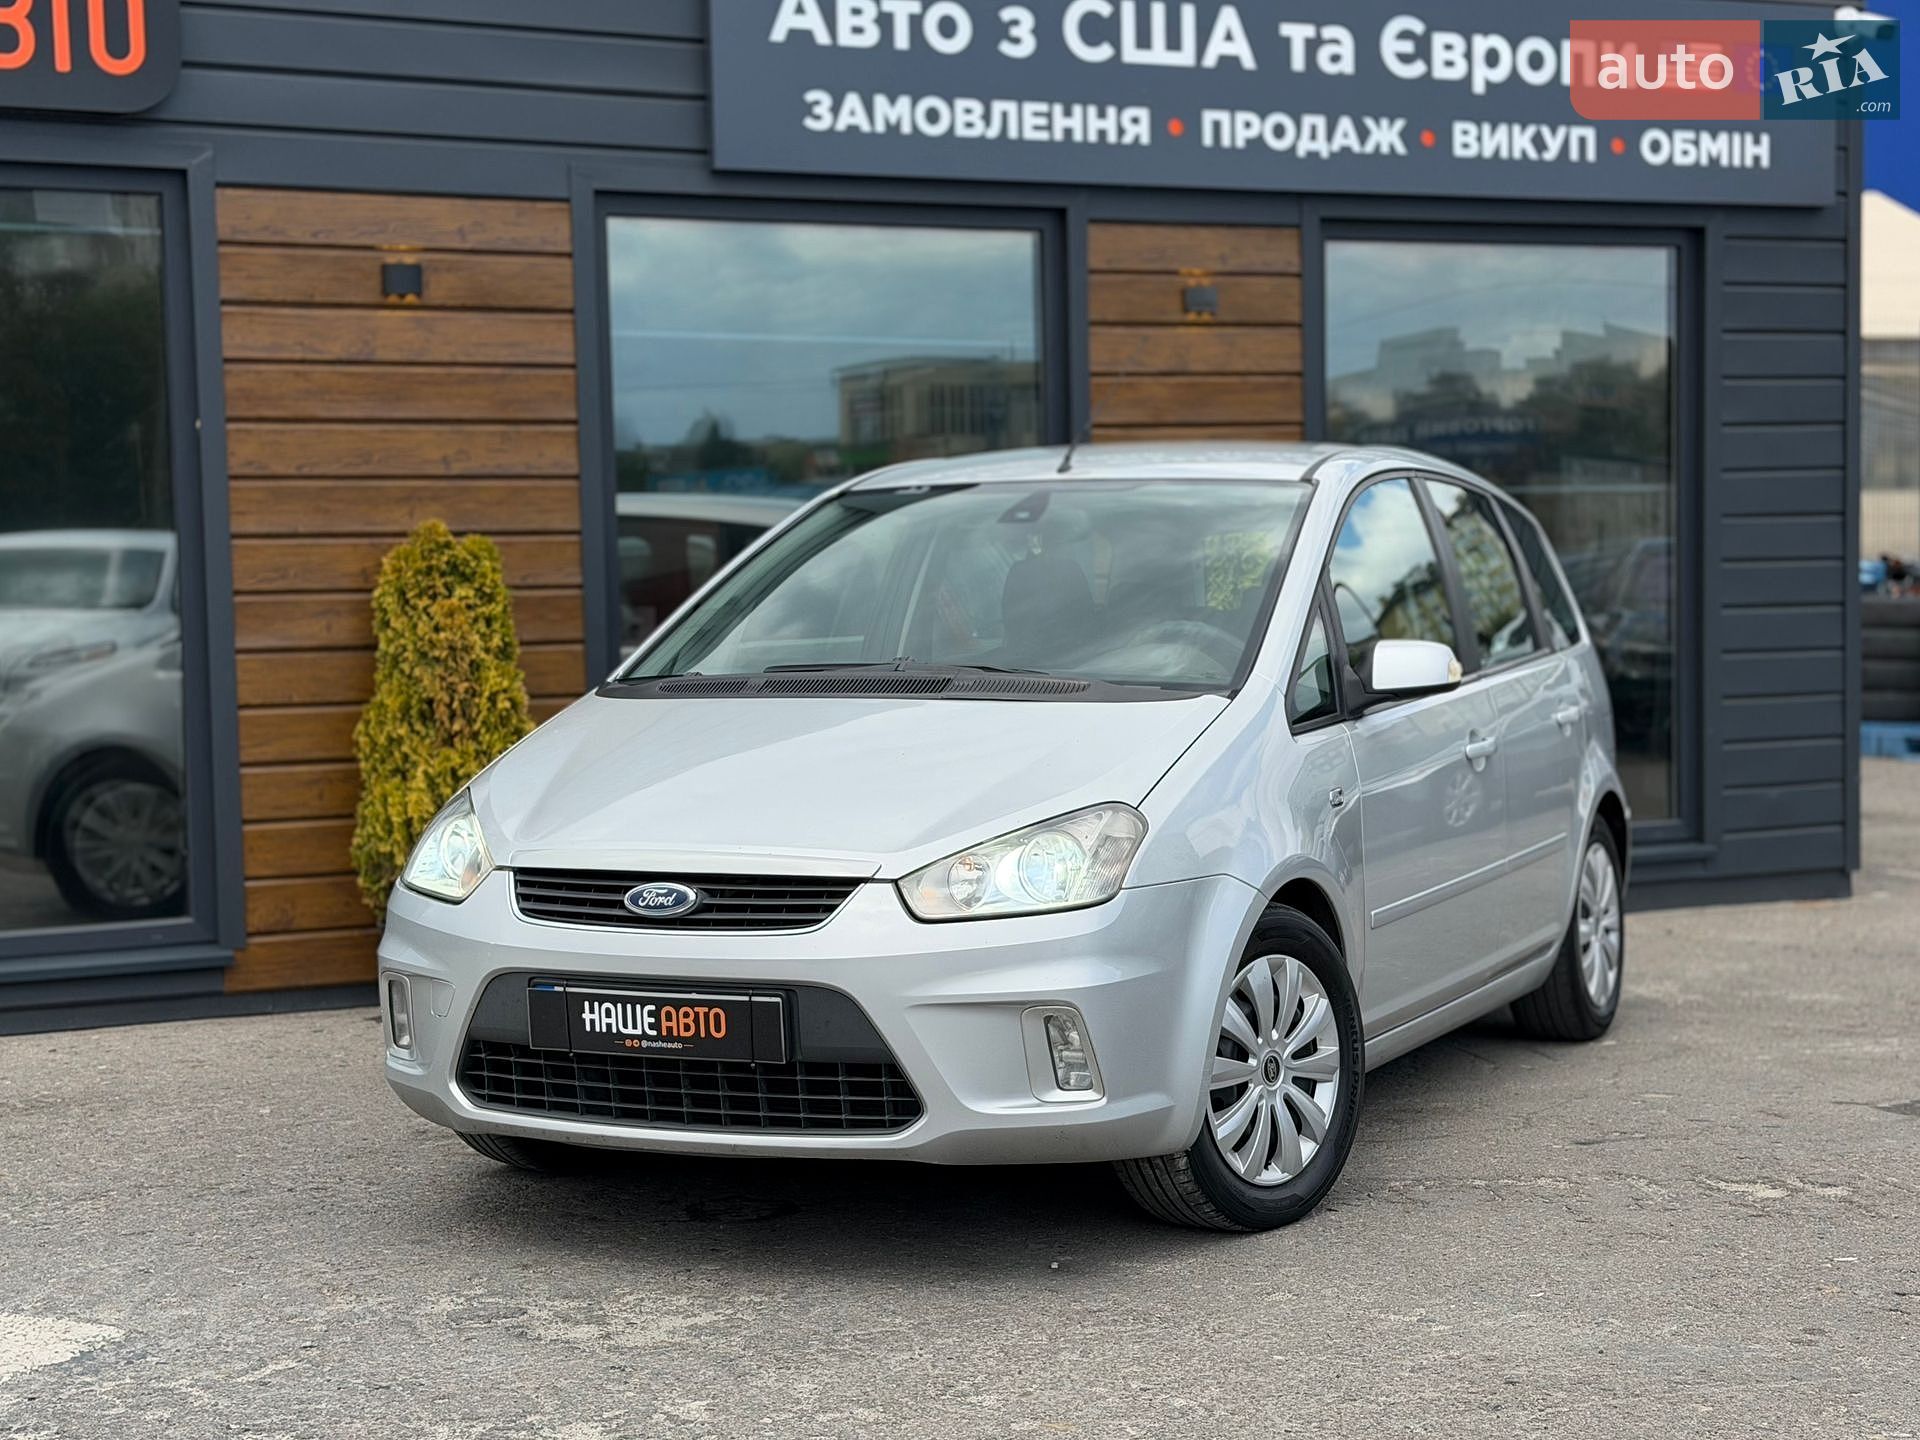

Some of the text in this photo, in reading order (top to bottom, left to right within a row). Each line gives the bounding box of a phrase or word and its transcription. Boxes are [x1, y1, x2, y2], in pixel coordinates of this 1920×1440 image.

[769, 0, 973, 55] Авто
[998, 5, 1037, 59] з
[1062, 0, 1257, 71] США
[1278, 22, 1355, 75] та
[802, 89, 1772, 169] ЗАМОВЛЕННЯ ПРОДАЖ ВИКУП ОБМІН
[638, 888, 678, 907] Ford
[582, 1000, 727, 1039] НАШЕ АВТО
[641, 1039, 683, 1048] @nasheauto
